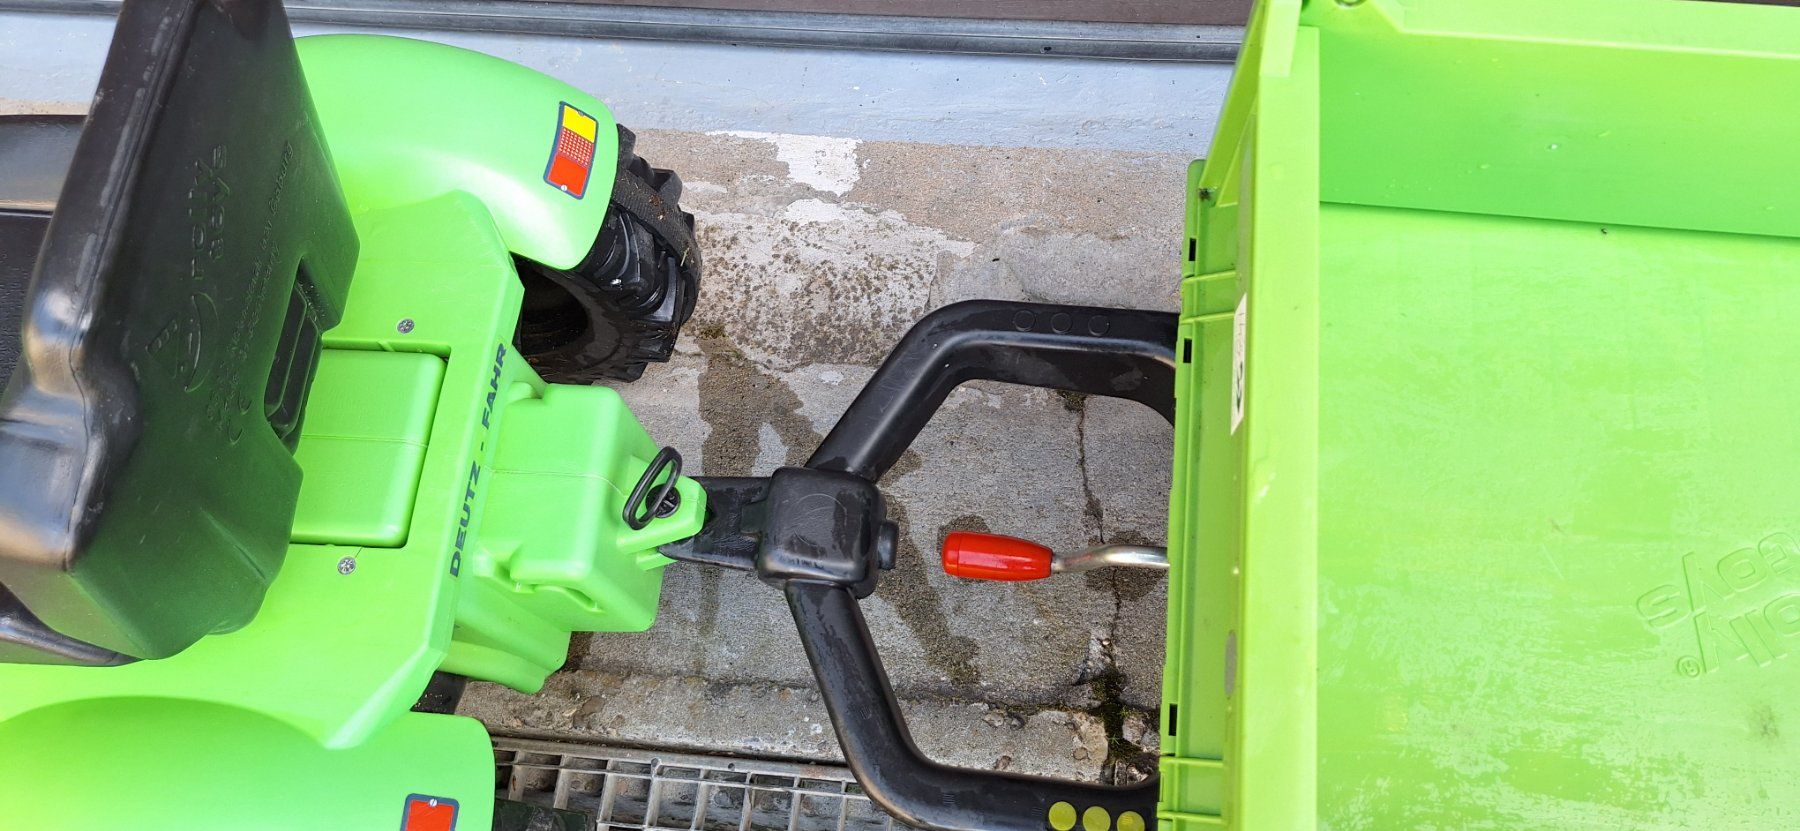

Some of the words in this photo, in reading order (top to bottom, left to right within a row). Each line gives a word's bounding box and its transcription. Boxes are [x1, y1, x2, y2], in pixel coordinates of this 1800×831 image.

[189, 159, 213, 280] rolly
[210, 143, 230, 262] toys
[450, 460, 481, 578] DEUTZ
[481, 342, 507, 430] FAHR
